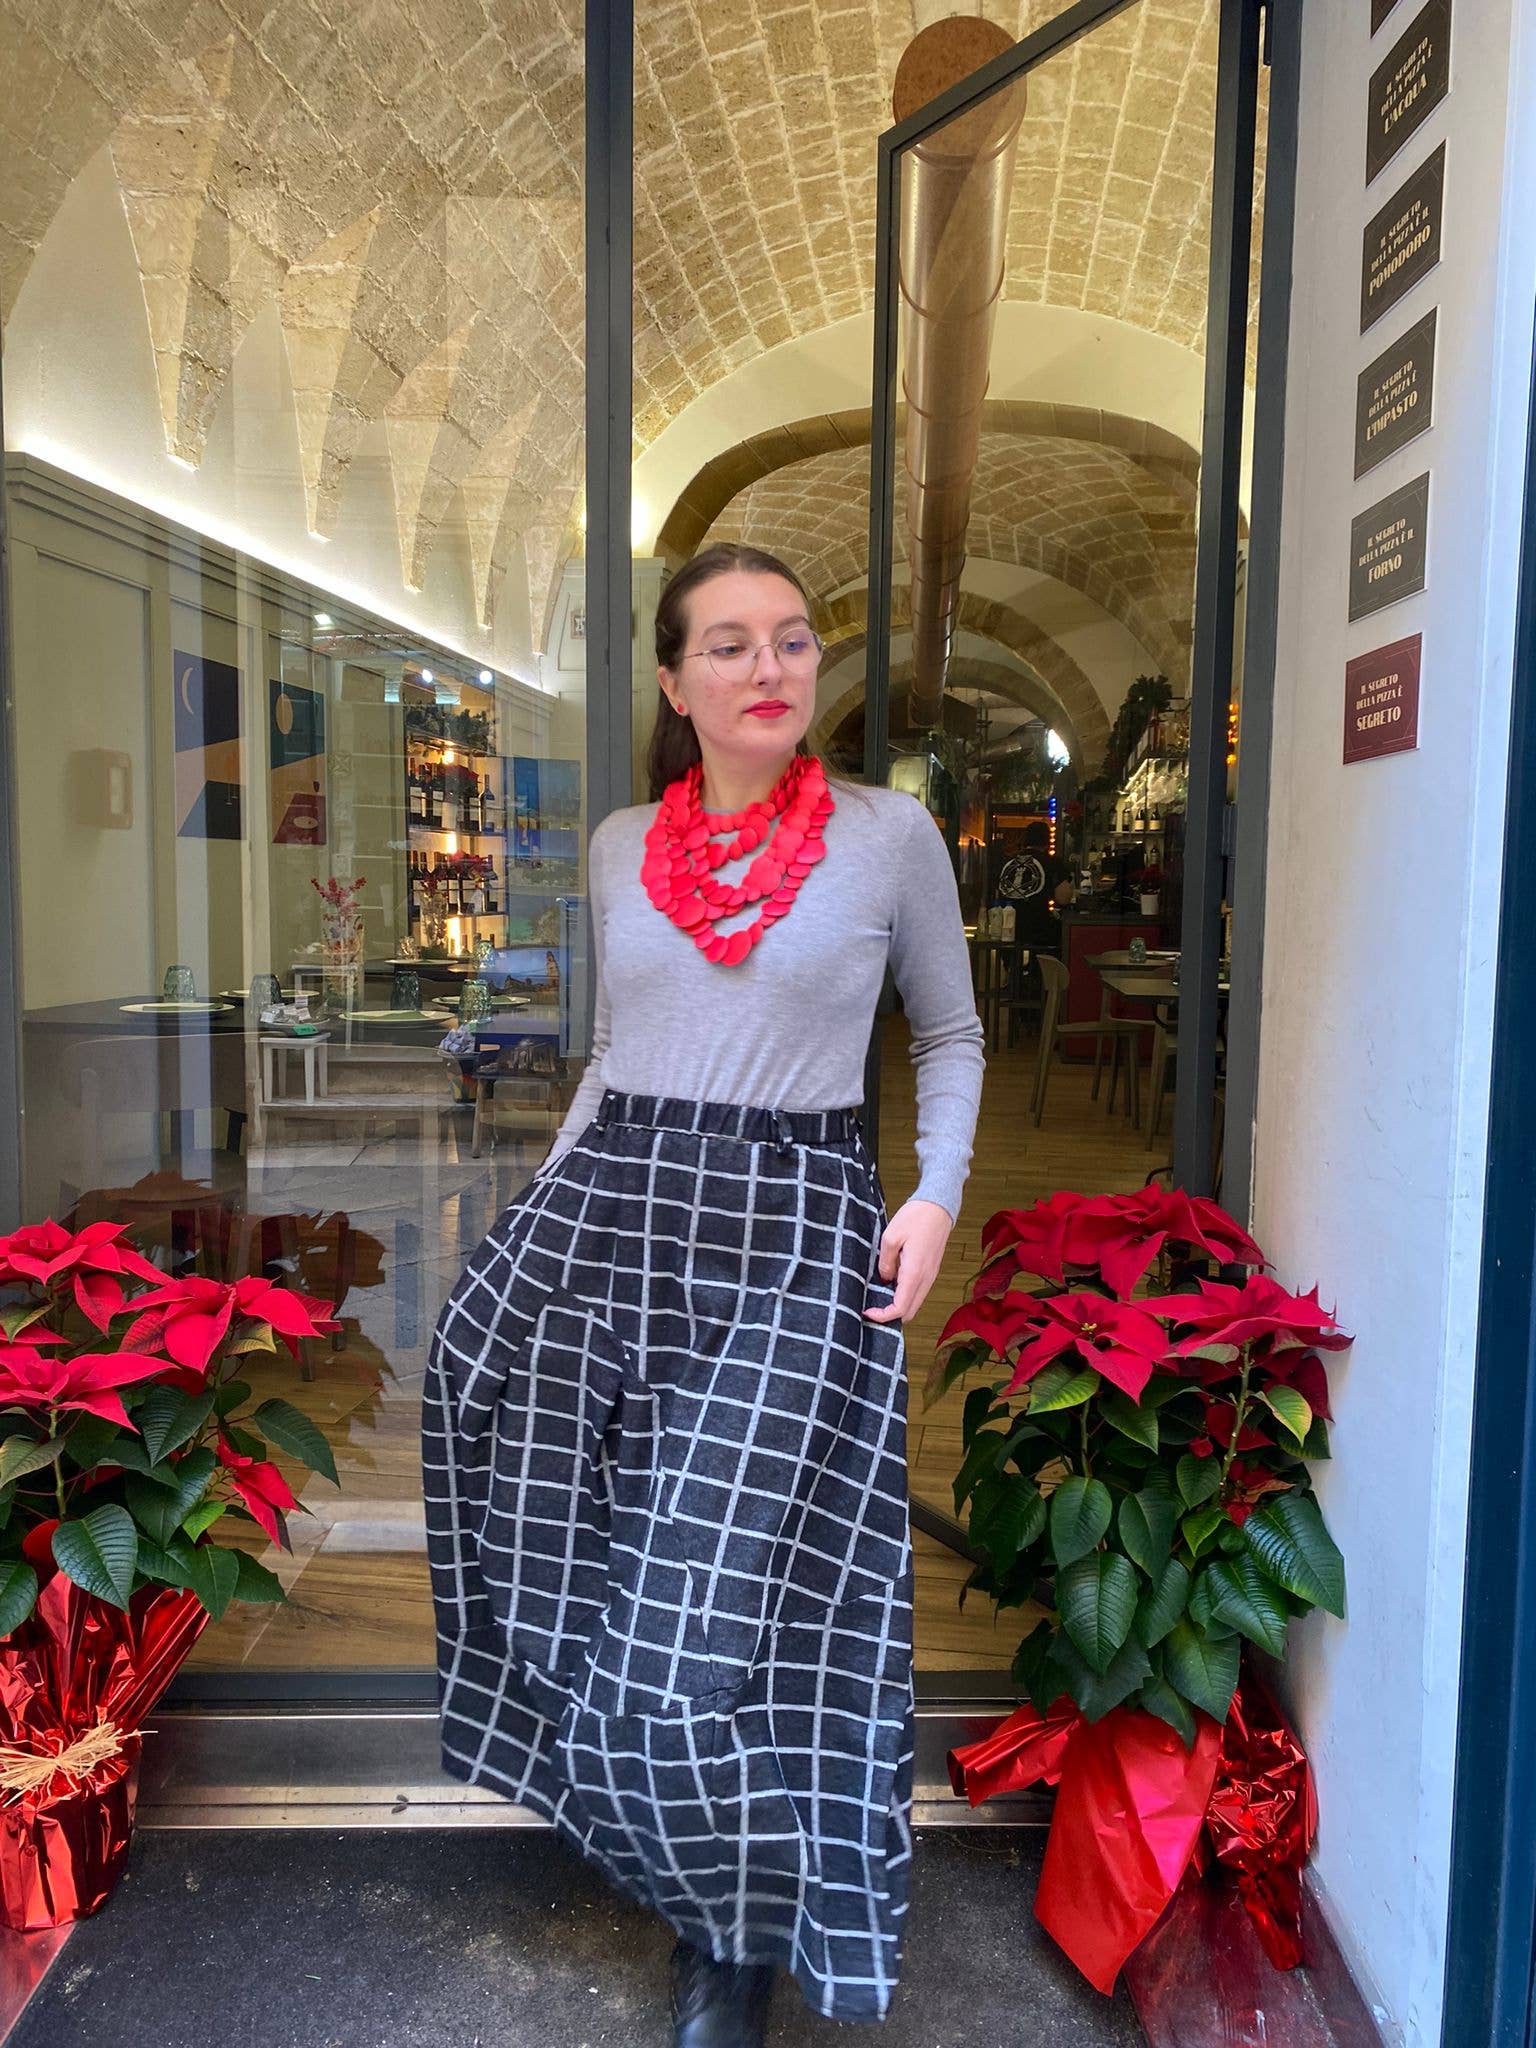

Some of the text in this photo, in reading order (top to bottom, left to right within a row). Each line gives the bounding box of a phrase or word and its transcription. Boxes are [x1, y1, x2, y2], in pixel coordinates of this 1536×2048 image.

[1384, 73, 1428, 135] L'ACQUA
[1389, 200, 1421, 240] SEGRETO
[1369, 224, 1431, 296] POMODORO
[1382, 360, 1414, 393] SEGRETO
[1368, 395, 1389, 418] DELLA
[1390, 377, 1411, 401] PIZZA
[1375, 518, 1406, 543] SEGRETO
[1359, 549, 1378, 567] DELLA
[1380, 536, 1399, 555] PIZZA
[1368, 554, 1402, 584] FORNO
[1368, 673, 1399, 692] SEGRETO
[1356, 696, 1375, 710] DELLA
[1376, 689, 1396, 704] PIZZA
[1356, 706, 1401, 731] SEGRETO
